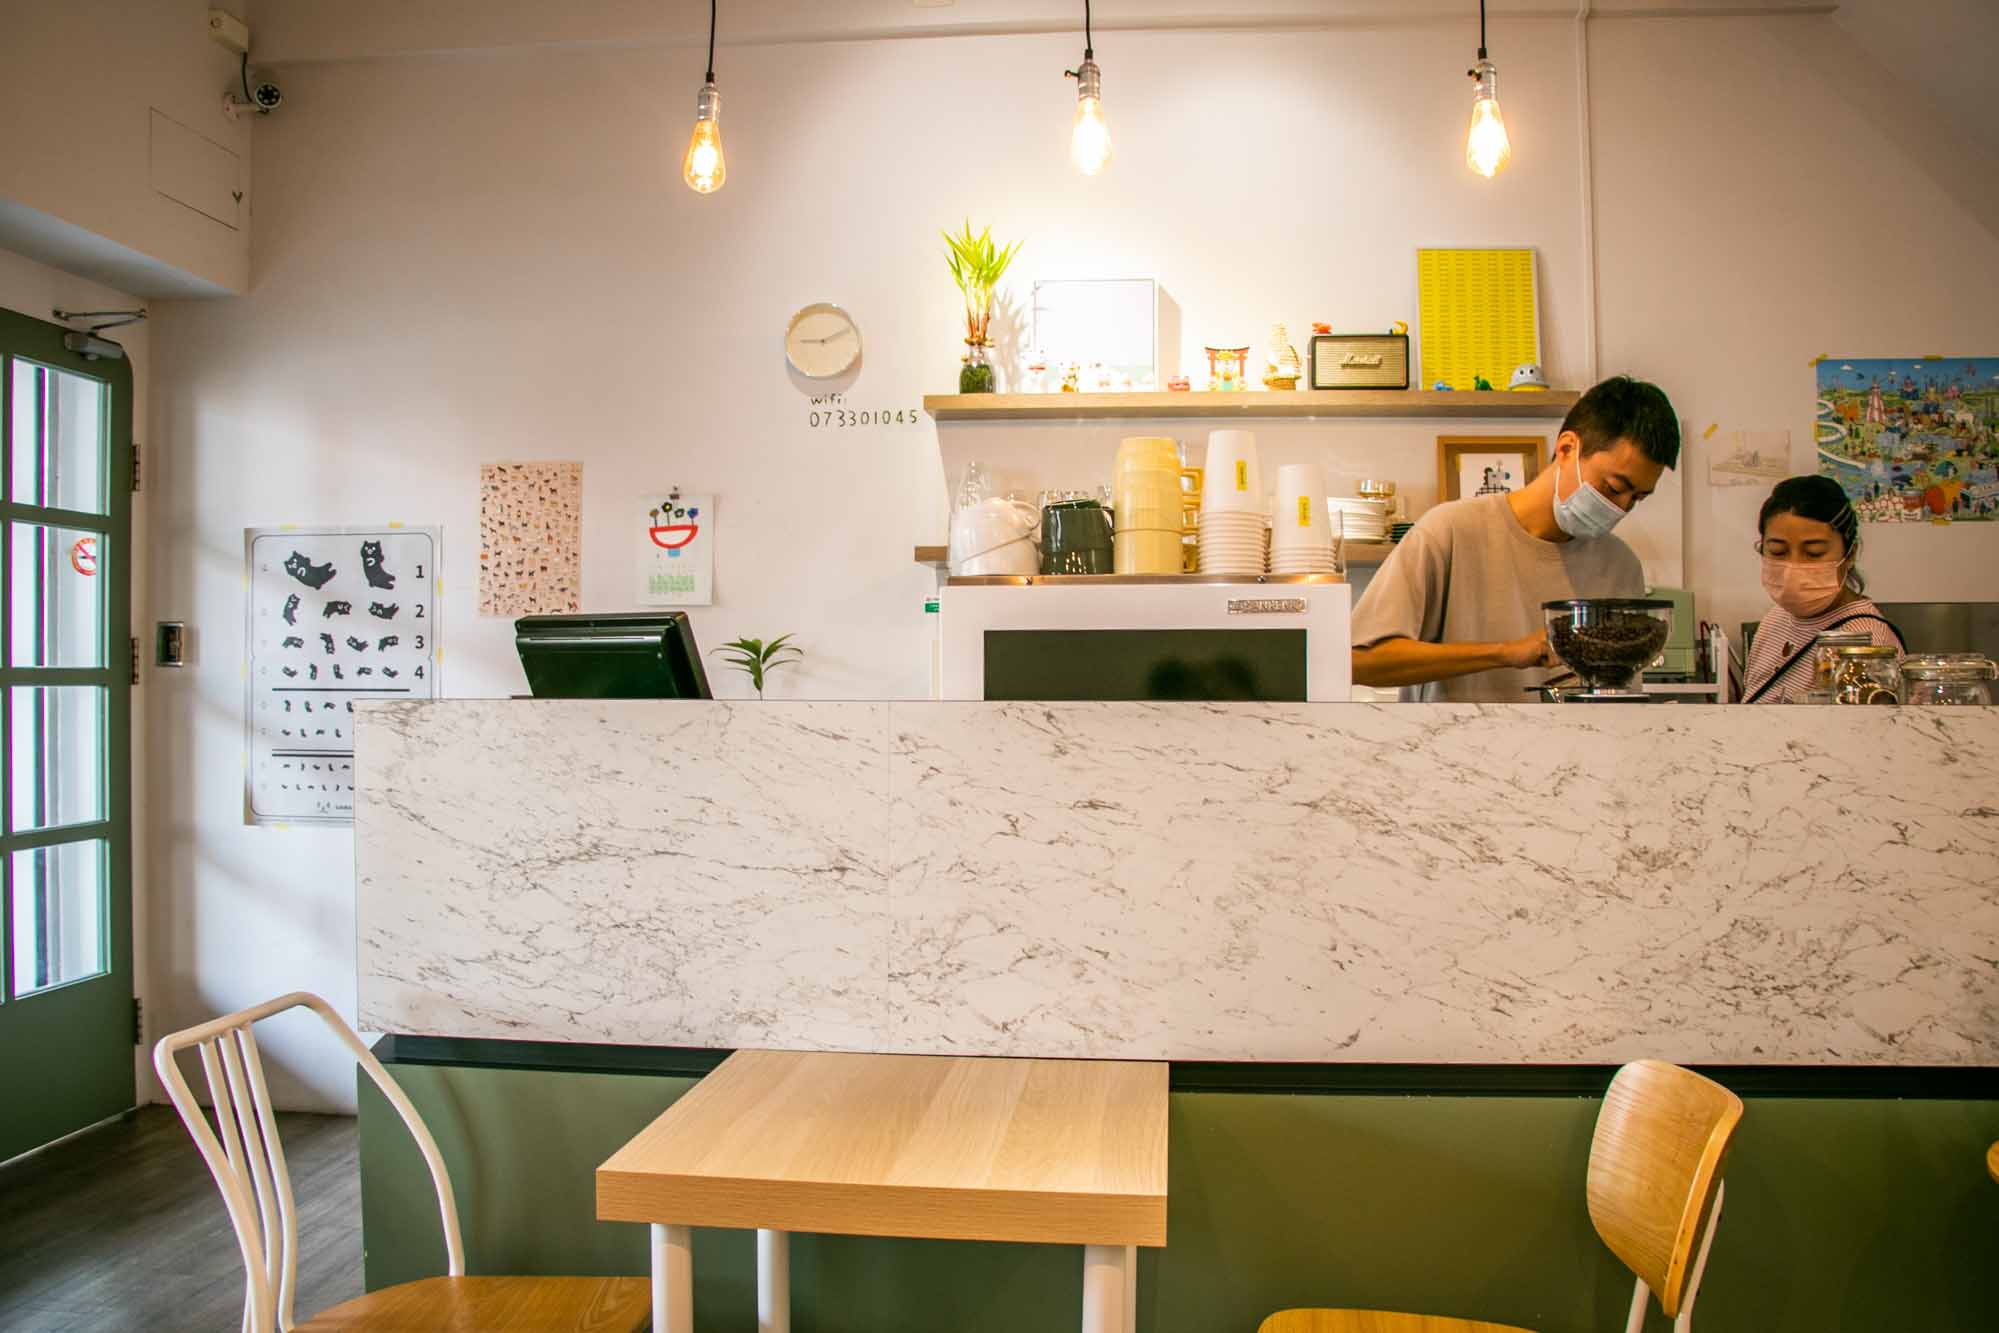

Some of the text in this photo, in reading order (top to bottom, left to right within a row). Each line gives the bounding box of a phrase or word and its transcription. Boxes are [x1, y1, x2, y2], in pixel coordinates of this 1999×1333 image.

[809, 409, 918, 428] 073301045
[415, 565, 425, 578] 1
[415, 604, 425, 618] 2
[415, 635, 425, 649] 3
[414, 665, 425, 679] 4
